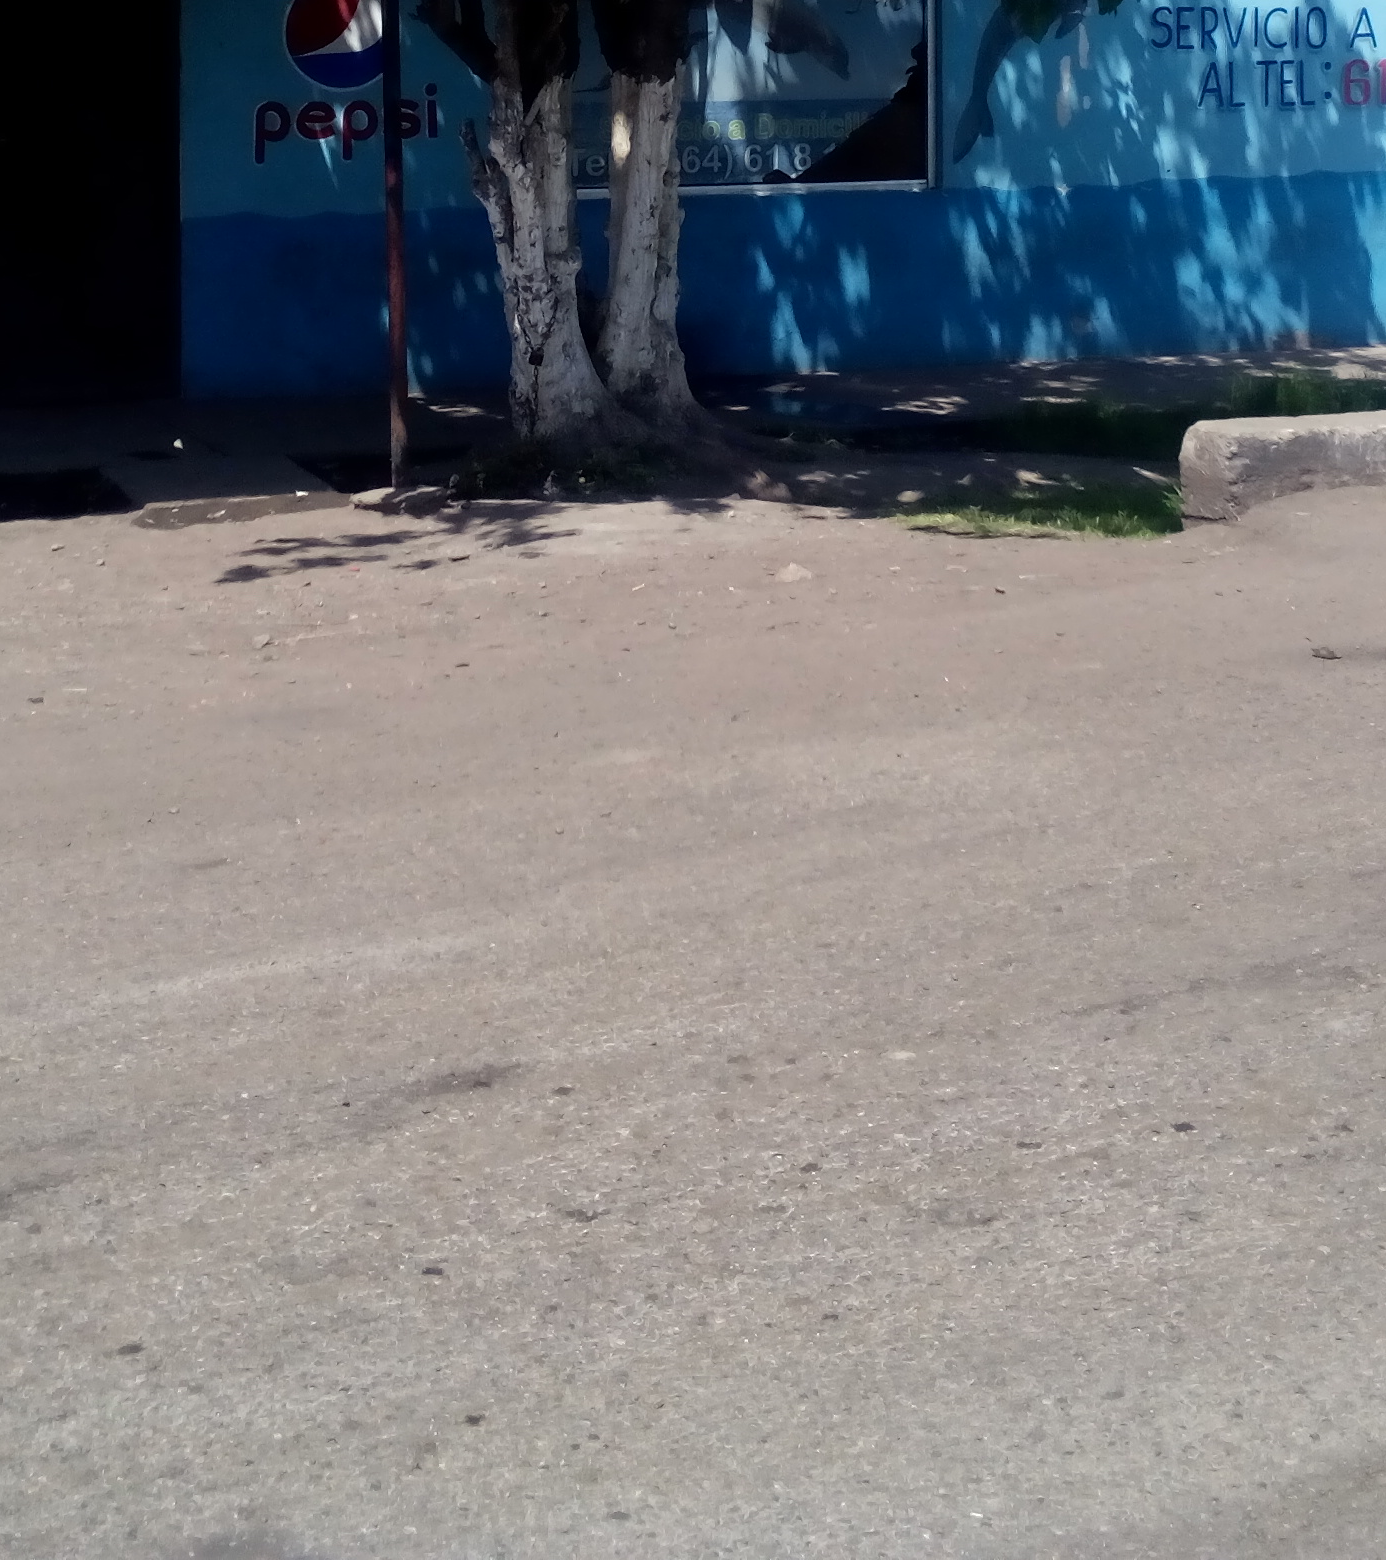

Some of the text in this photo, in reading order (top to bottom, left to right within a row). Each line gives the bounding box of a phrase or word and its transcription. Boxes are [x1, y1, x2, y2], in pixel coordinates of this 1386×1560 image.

[1149, 6, 1328, 50] SERVICIO
[1349, 7, 1378, 49] A
[1198, 60, 1245, 109] AL
[253, 82, 438, 164] pepsi
[727, 119, 746, 140] a
